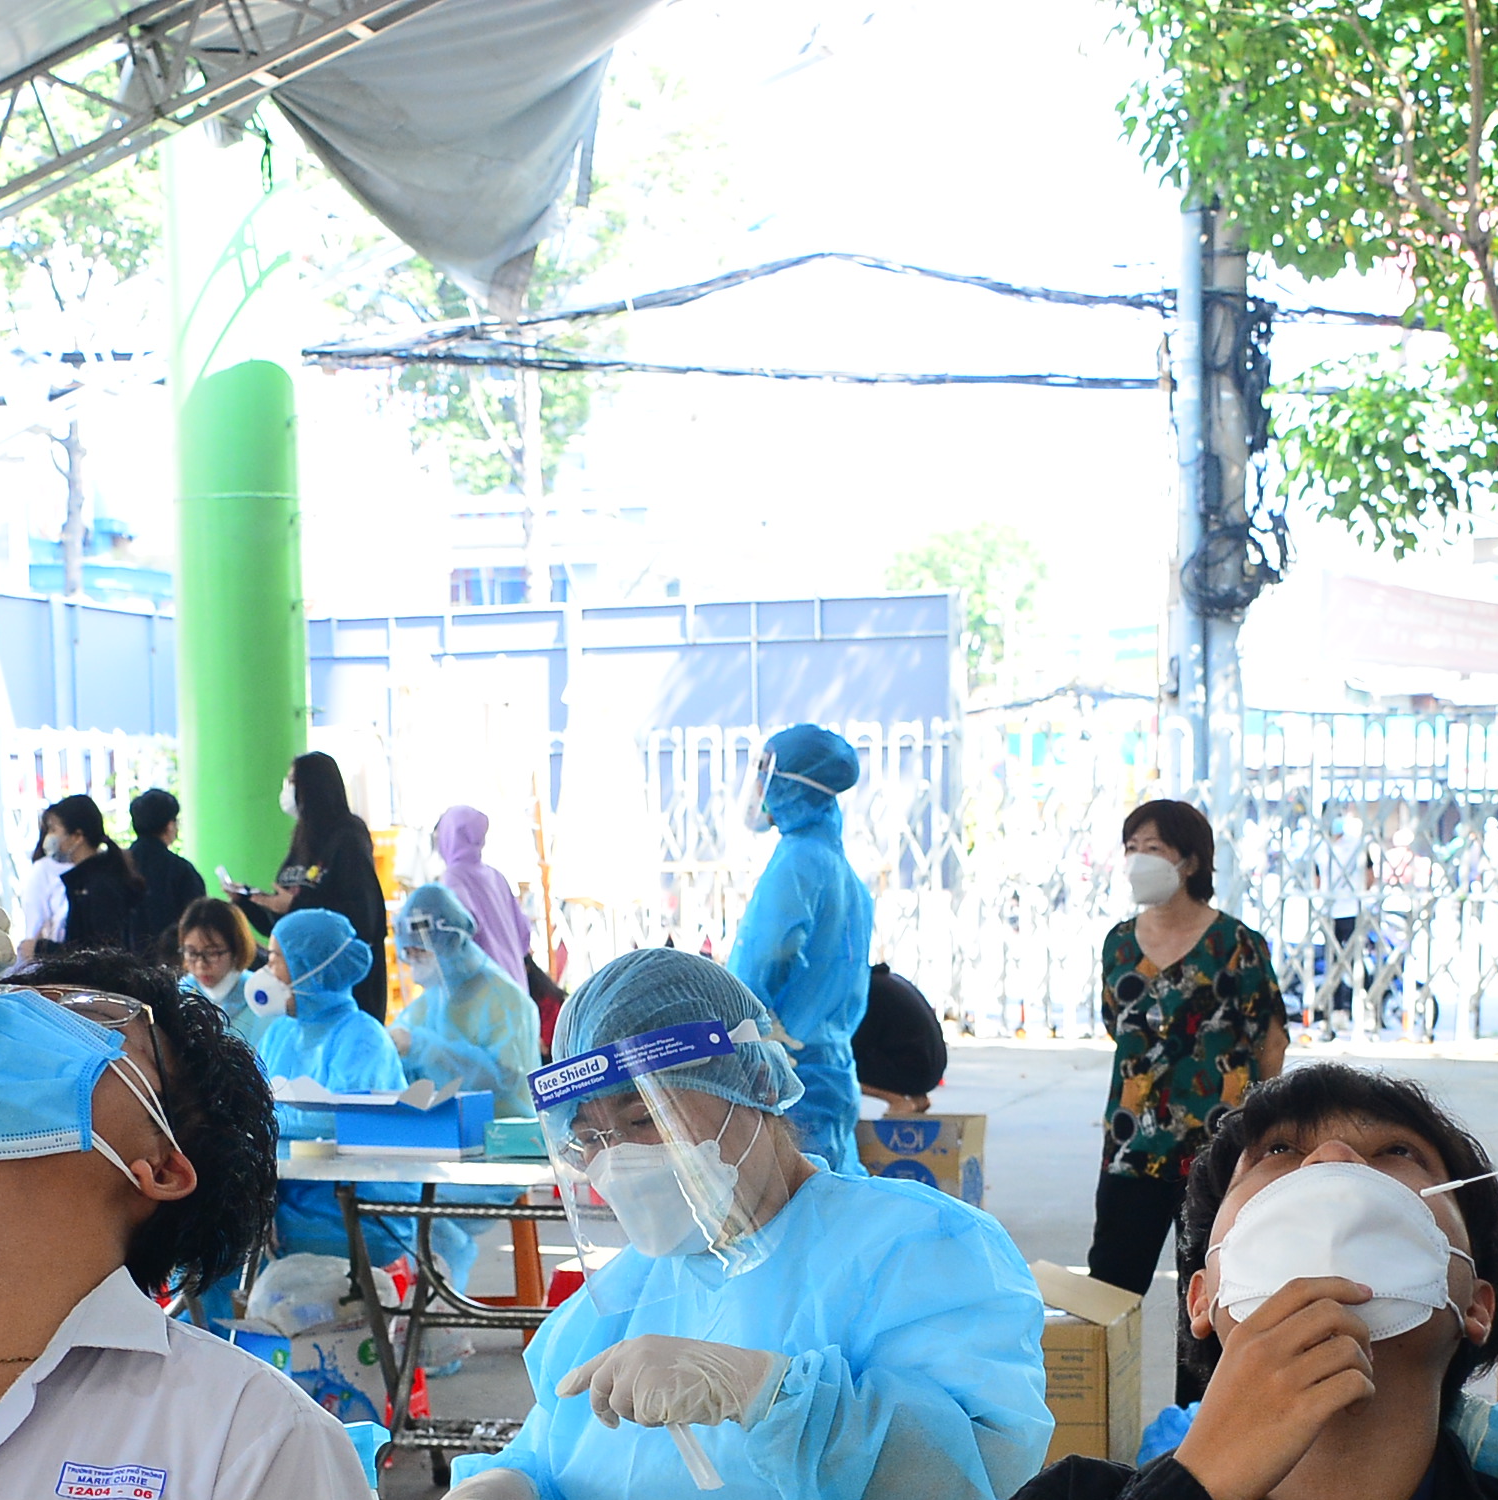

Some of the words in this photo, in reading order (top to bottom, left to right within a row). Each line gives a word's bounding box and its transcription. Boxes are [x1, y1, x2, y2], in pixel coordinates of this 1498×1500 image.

[537, 1074, 559, 1092] Face
[561, 1061, 601, 1084] Shield
[554, 1086, 571, 1098] Splash
[572, 1075, 605, 1091] Protection
[77, 1476, 110, 1485] MARIE
[114, 1476, 148, 1485] CURIE
[68, 1487, 111, 1496] 12A04
[134, 1488, 153, 1499] 06
